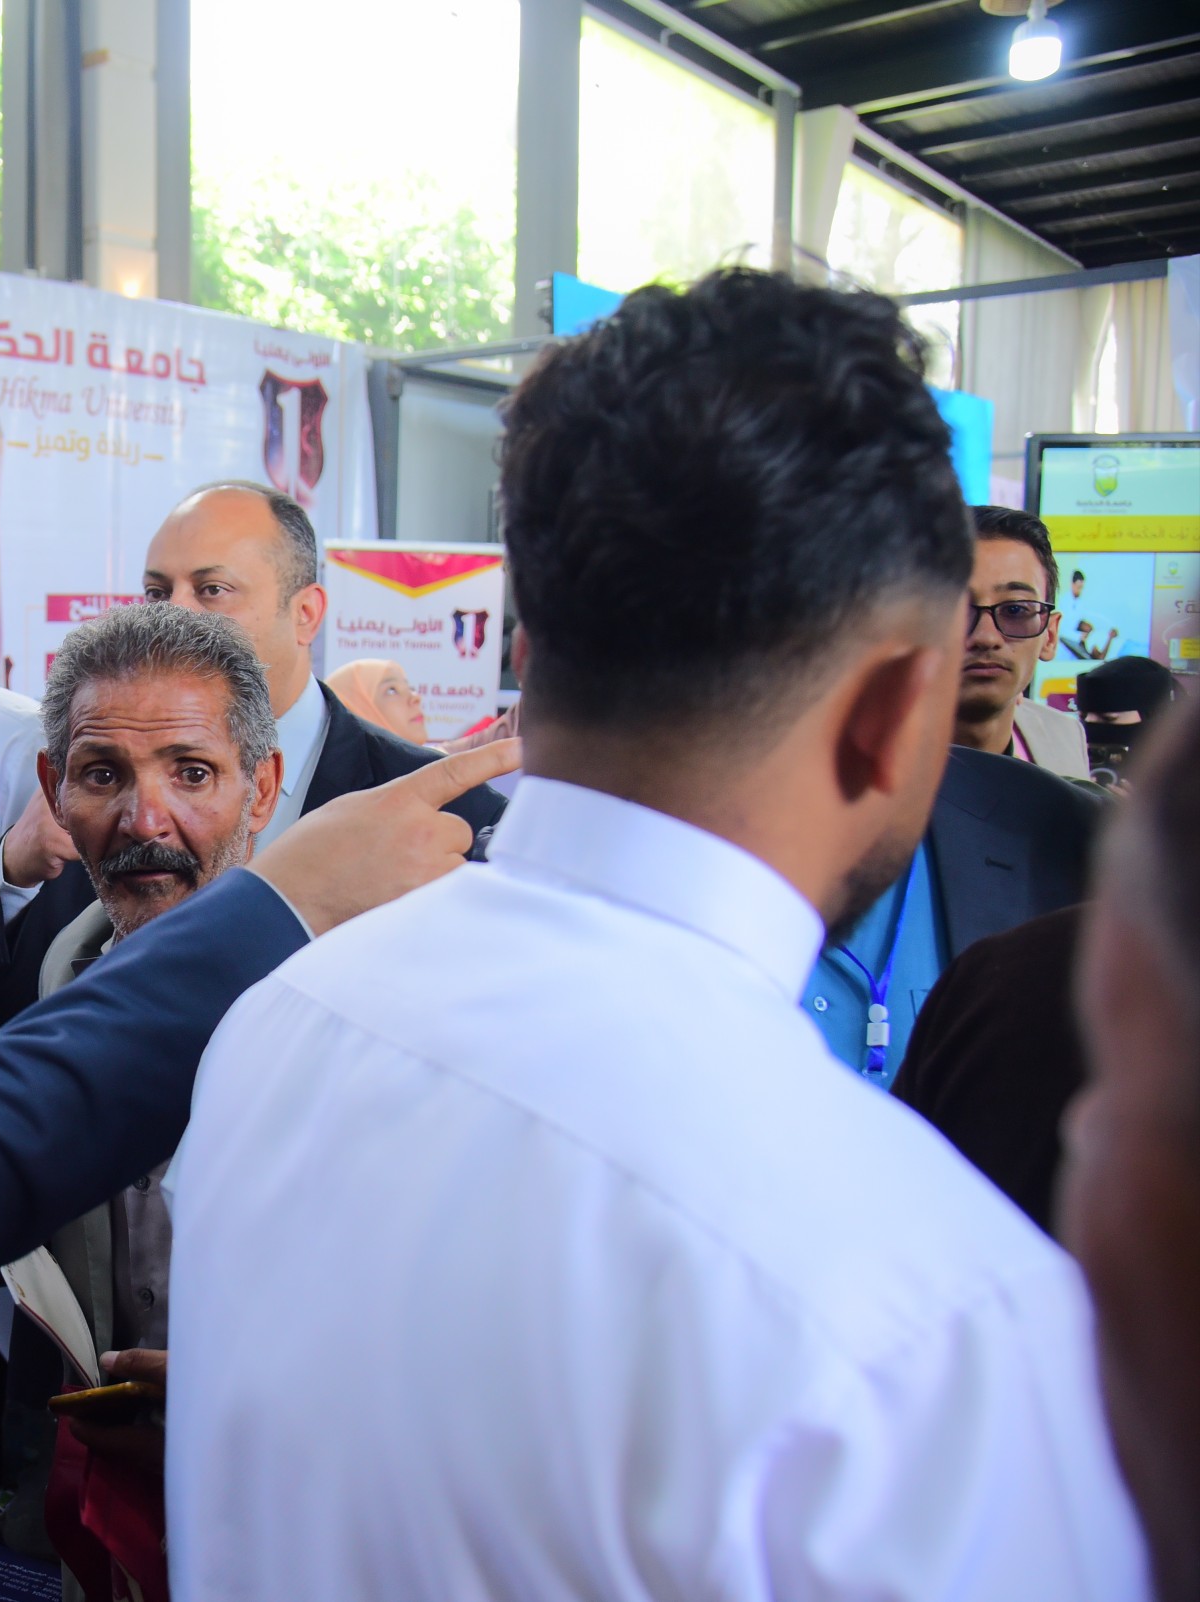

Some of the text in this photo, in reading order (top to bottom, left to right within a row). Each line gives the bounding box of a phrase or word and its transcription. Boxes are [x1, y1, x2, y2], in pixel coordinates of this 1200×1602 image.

[86, 332, 207, 393] جامعة
[338, 638, 357, 649] The
[361, 638, 385, 649] First
